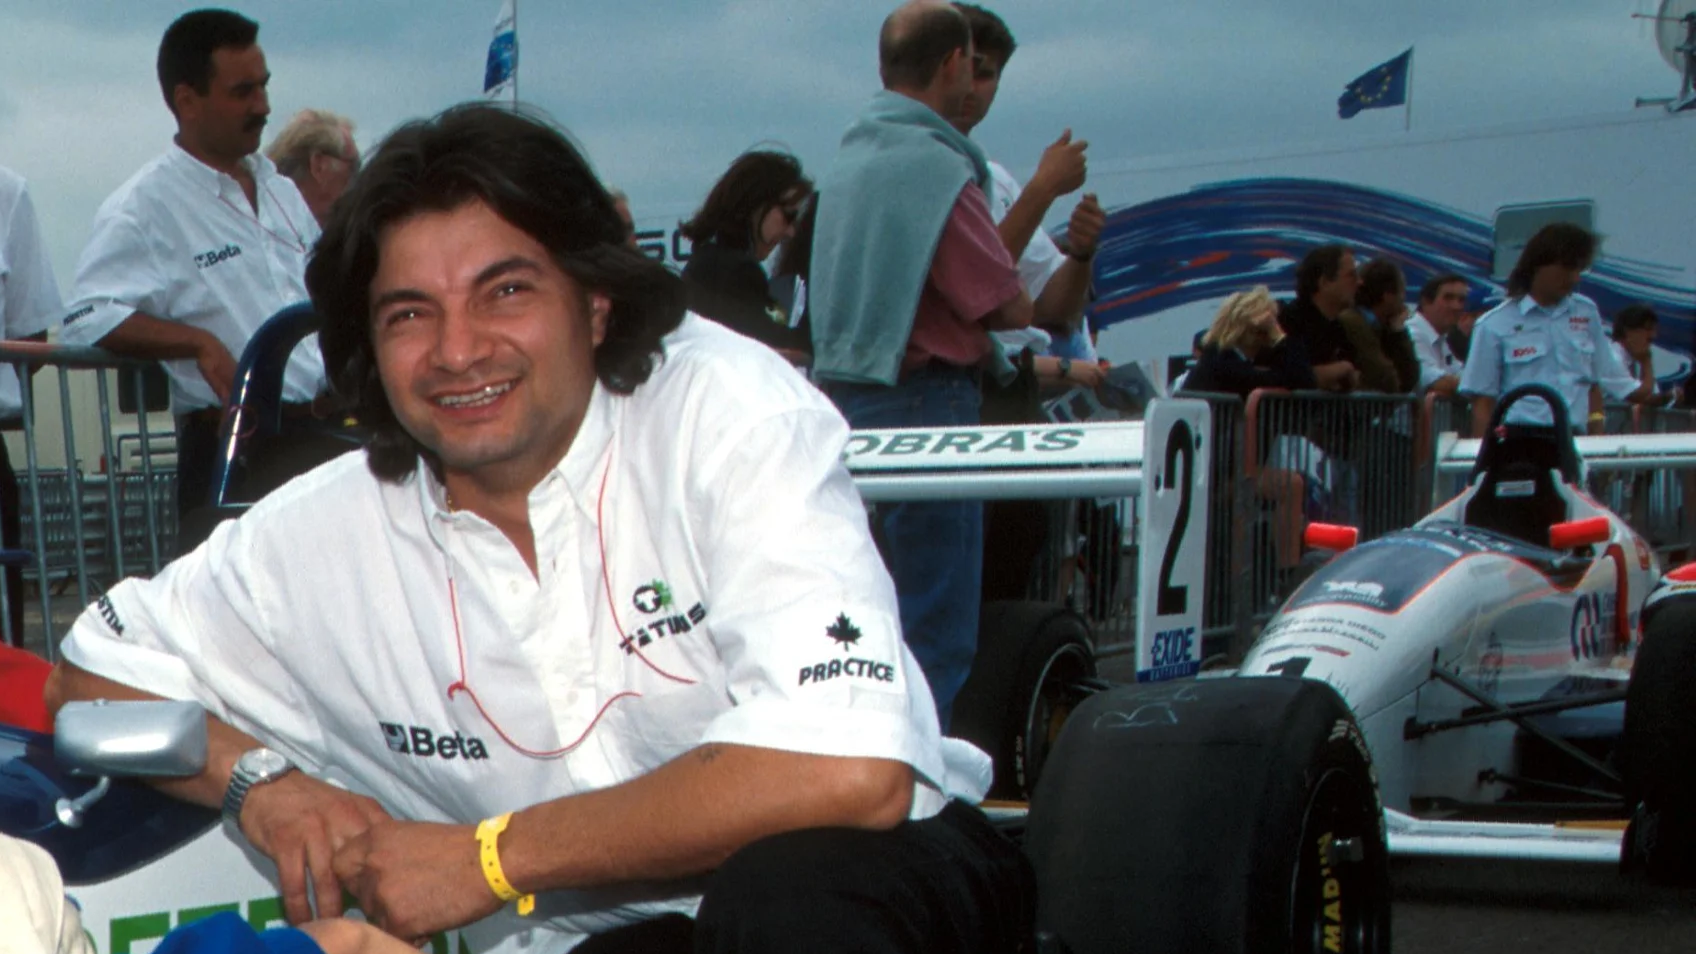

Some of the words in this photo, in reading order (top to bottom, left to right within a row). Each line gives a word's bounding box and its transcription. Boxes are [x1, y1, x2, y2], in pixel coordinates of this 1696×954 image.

[1157, 419, 1193, 616] 2
[1151, 626, 1195, 667] EXIDE
[798, 657, 895, 687] PRACTICE
[408, 725, 490, 761] Beta
